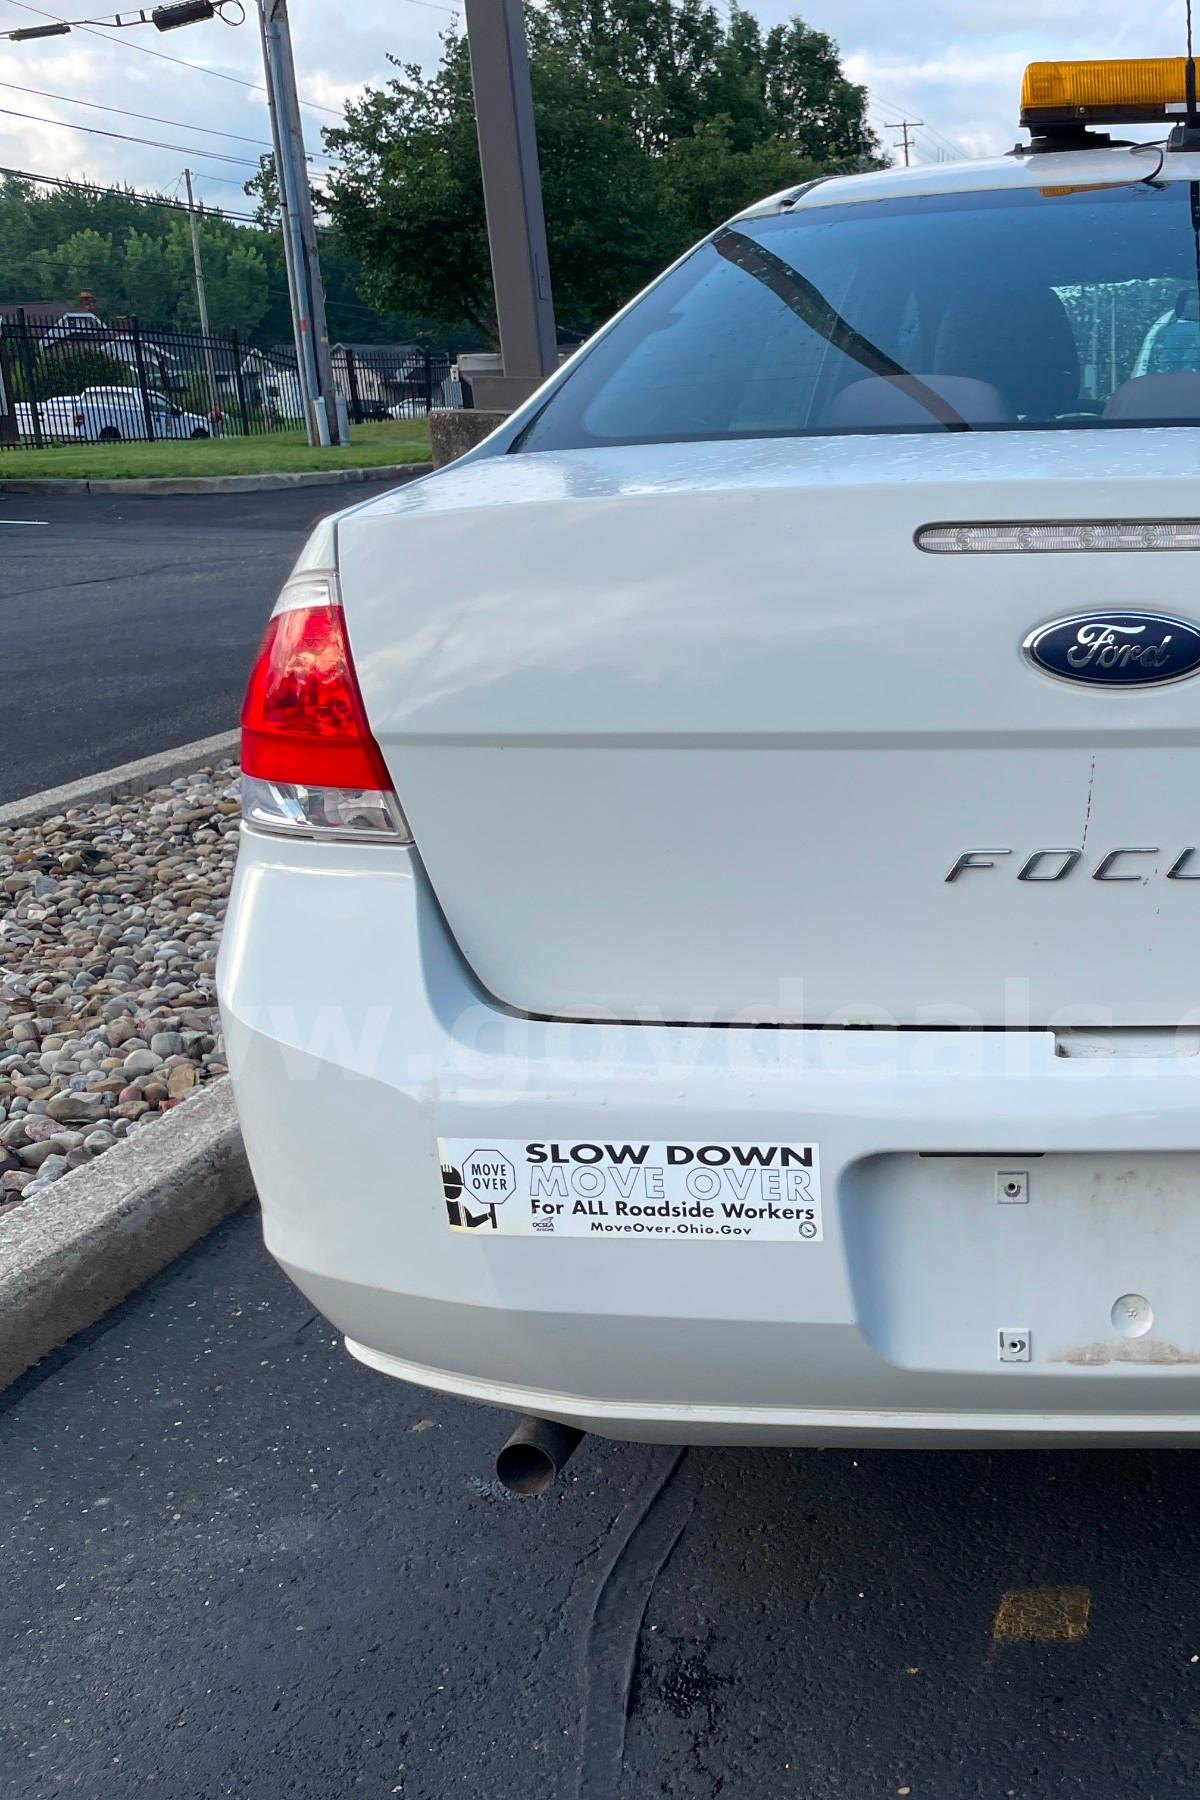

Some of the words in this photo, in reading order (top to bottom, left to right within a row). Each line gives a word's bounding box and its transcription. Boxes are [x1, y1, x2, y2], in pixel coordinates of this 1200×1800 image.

[1067, 624, 1172, 668] Ford
[526, 1143, 650, 1165] SLOW
[666, 1145, 813, 1167] DOWN
[471, 1164, 506, 1176] MOVE
[472, 1177, 508, 1191] OVER
[529, 1165, 665, 1199] MOVE
[686, 1166, 815, 1202] OVER
[530, 1199, 564, 1214] For
[572, 1200, 608, 1216] ALL
[616, 1200, 715, 1218] Roadside
[721, 1202, 815, 1220] Workers
[590, 1221, 752, 1235] MoveOver.Ohio.Gov
